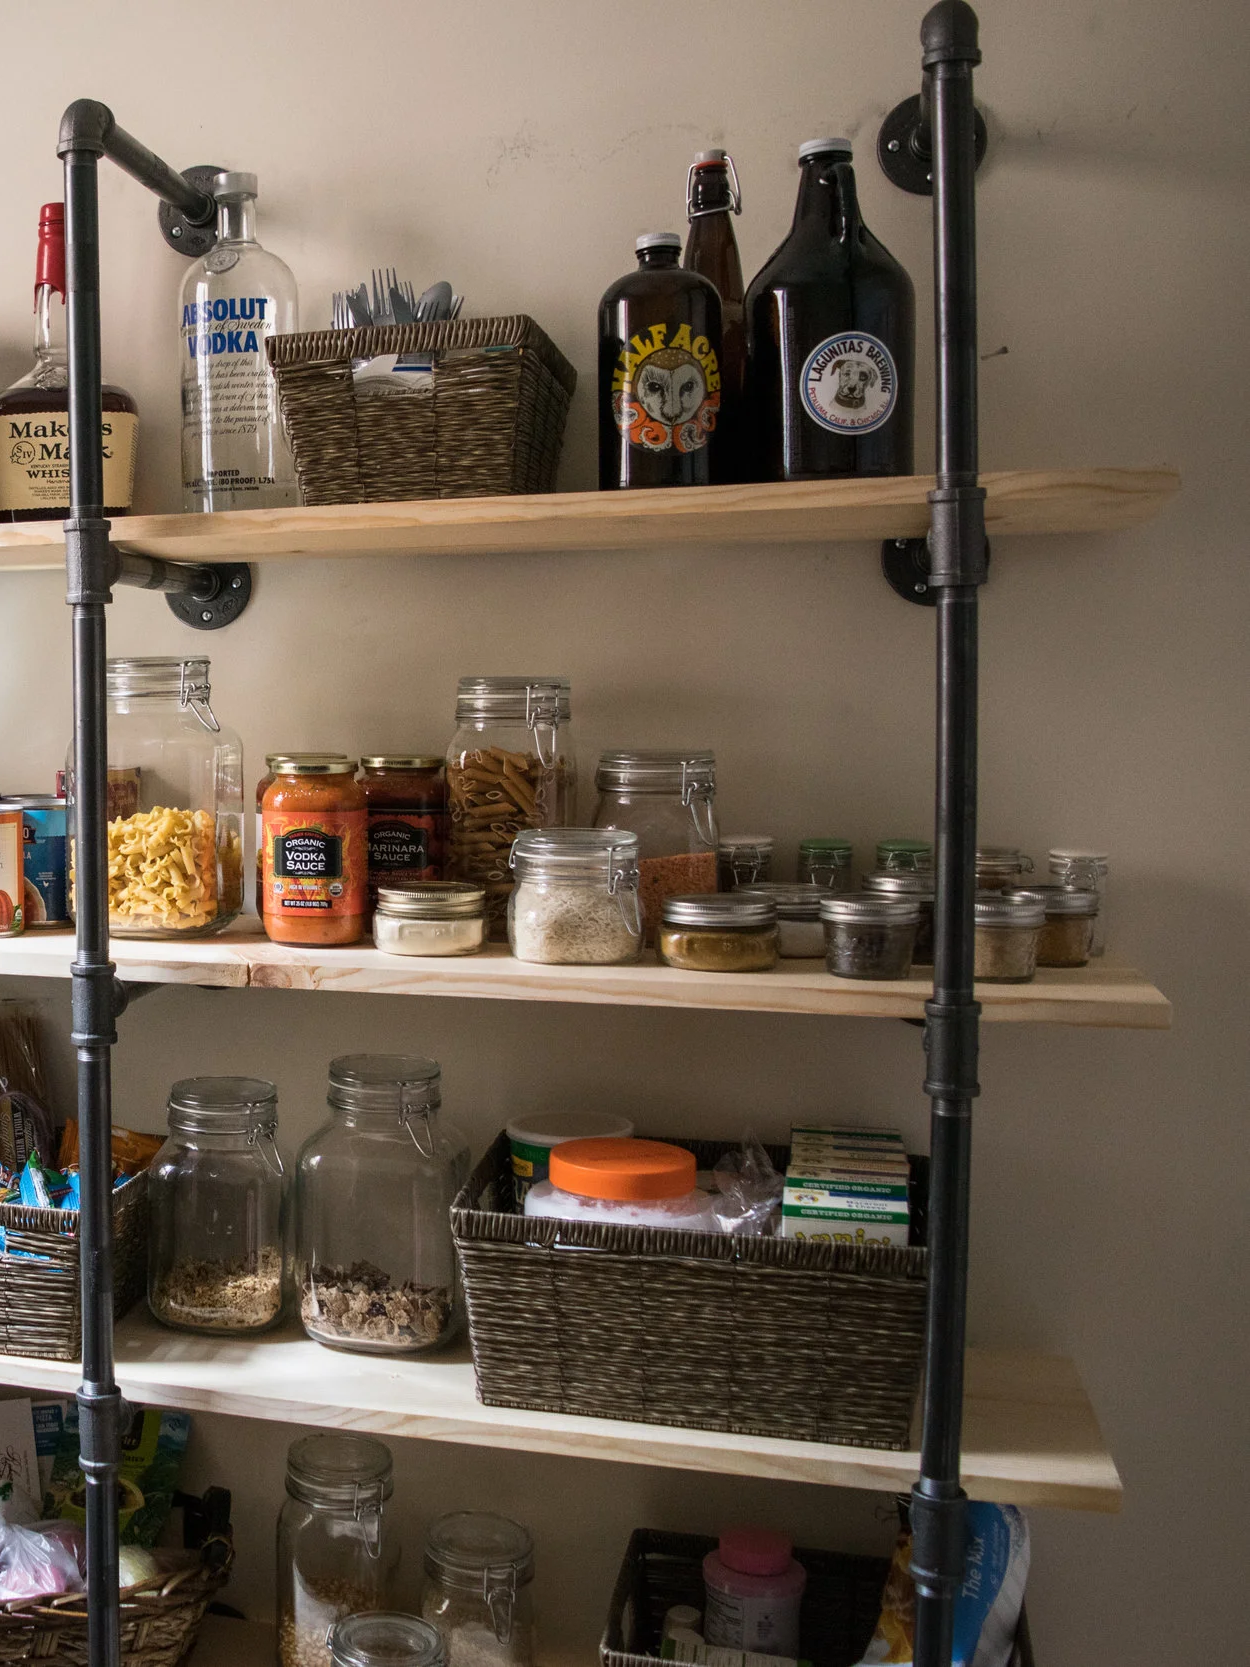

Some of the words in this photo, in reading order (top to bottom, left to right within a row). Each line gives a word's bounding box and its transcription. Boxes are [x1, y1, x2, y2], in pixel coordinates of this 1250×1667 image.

[182, 298, 267, 327] ABSOLUT
[188, 331, 258, 358] VODKA
[611, 323, 667, 391] HALF
[669, 323, 721, 392] ACRE
[809, 340, 863, 382] LAGUNITAS
[866, 346, 892, 394] BREWING
[9, 421, 112, 439] Maks
[26, 470, 70, 479] WHIS
[374, 830, 411, 840] ORGANIC
[285, 838, 326, 848] ORGANIC
[285, 851, 326, 861] VODKA
[374, 853, 411, 862] SAUCE
[286, 861, 326, 870] SAUCE
[803, 1182, 850, 1191] CERTIFIED
[801, 1208, 850, 1217] CERTIFIED
[962, 1569, 982, 1600] The
